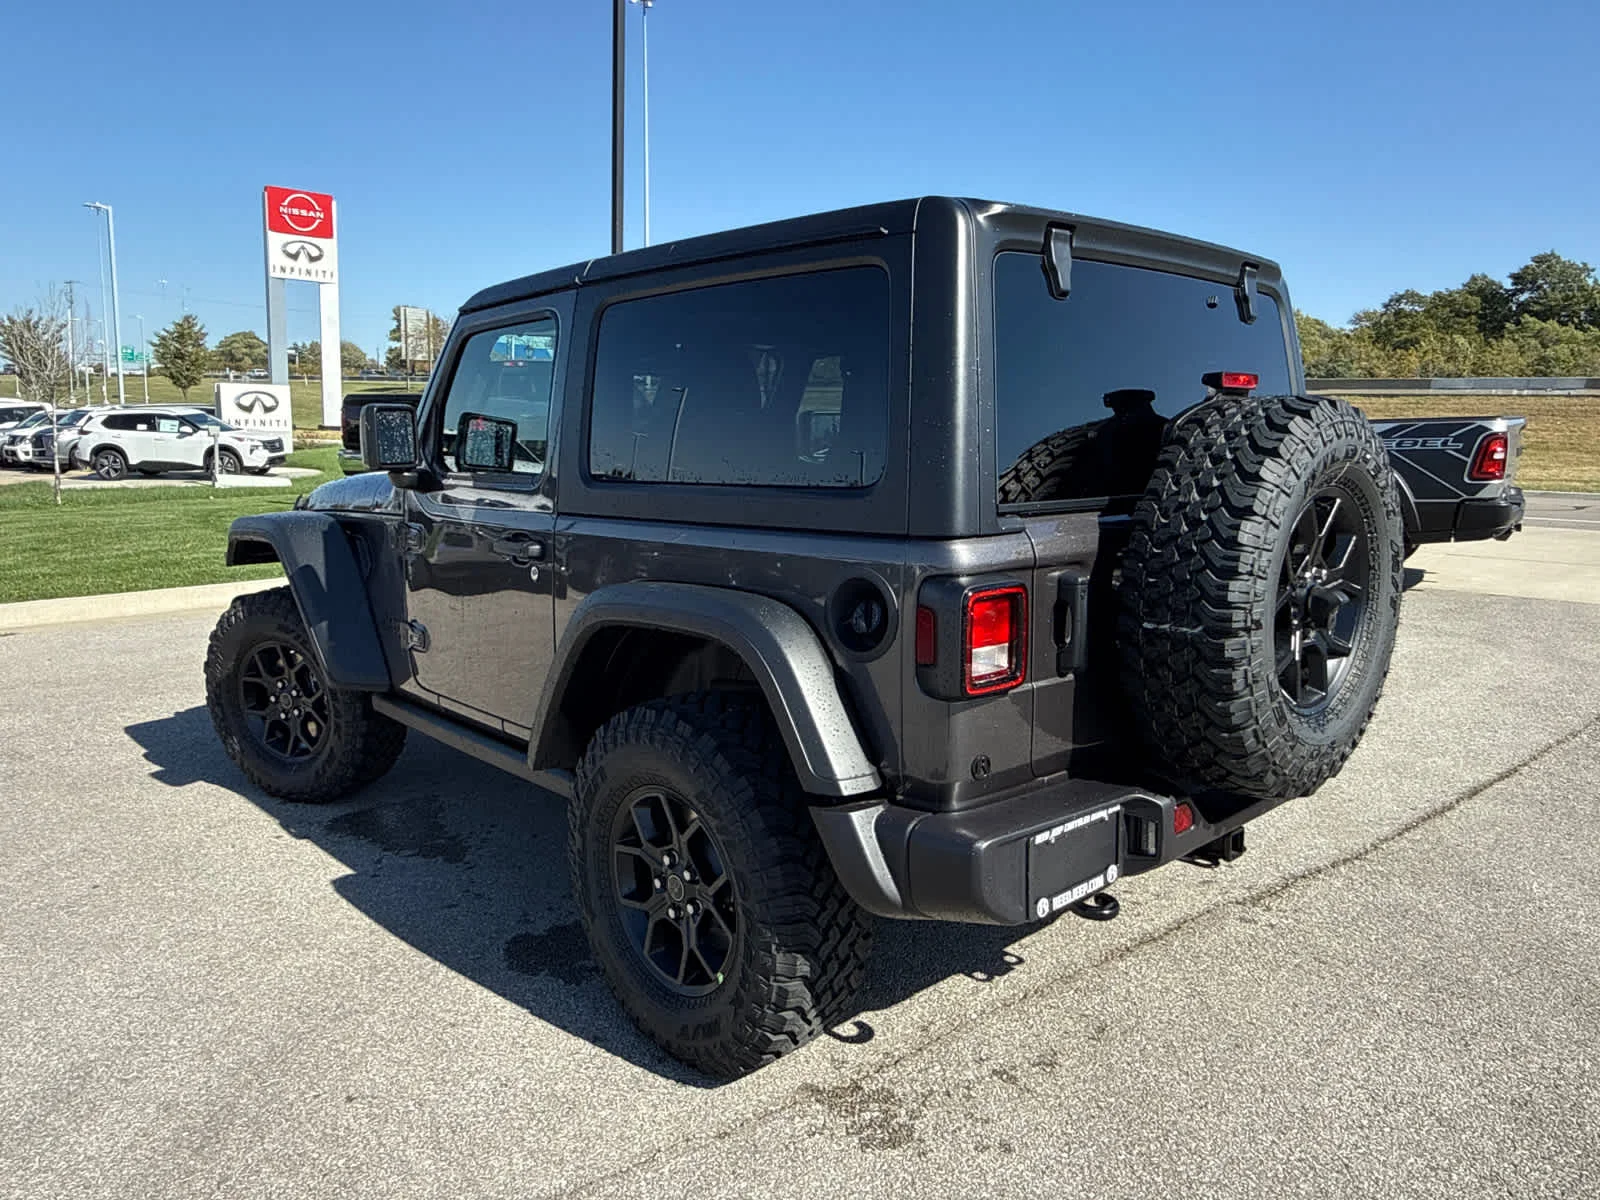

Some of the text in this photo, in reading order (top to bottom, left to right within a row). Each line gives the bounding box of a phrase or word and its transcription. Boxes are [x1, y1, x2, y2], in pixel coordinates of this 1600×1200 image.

[279, 205, 325, 219] NISSAN
[272, 264, 335, 280] INFINITI
[227, 418, 288, 428] INFINITI
[1383, 437, 1464, 450] EBEL
